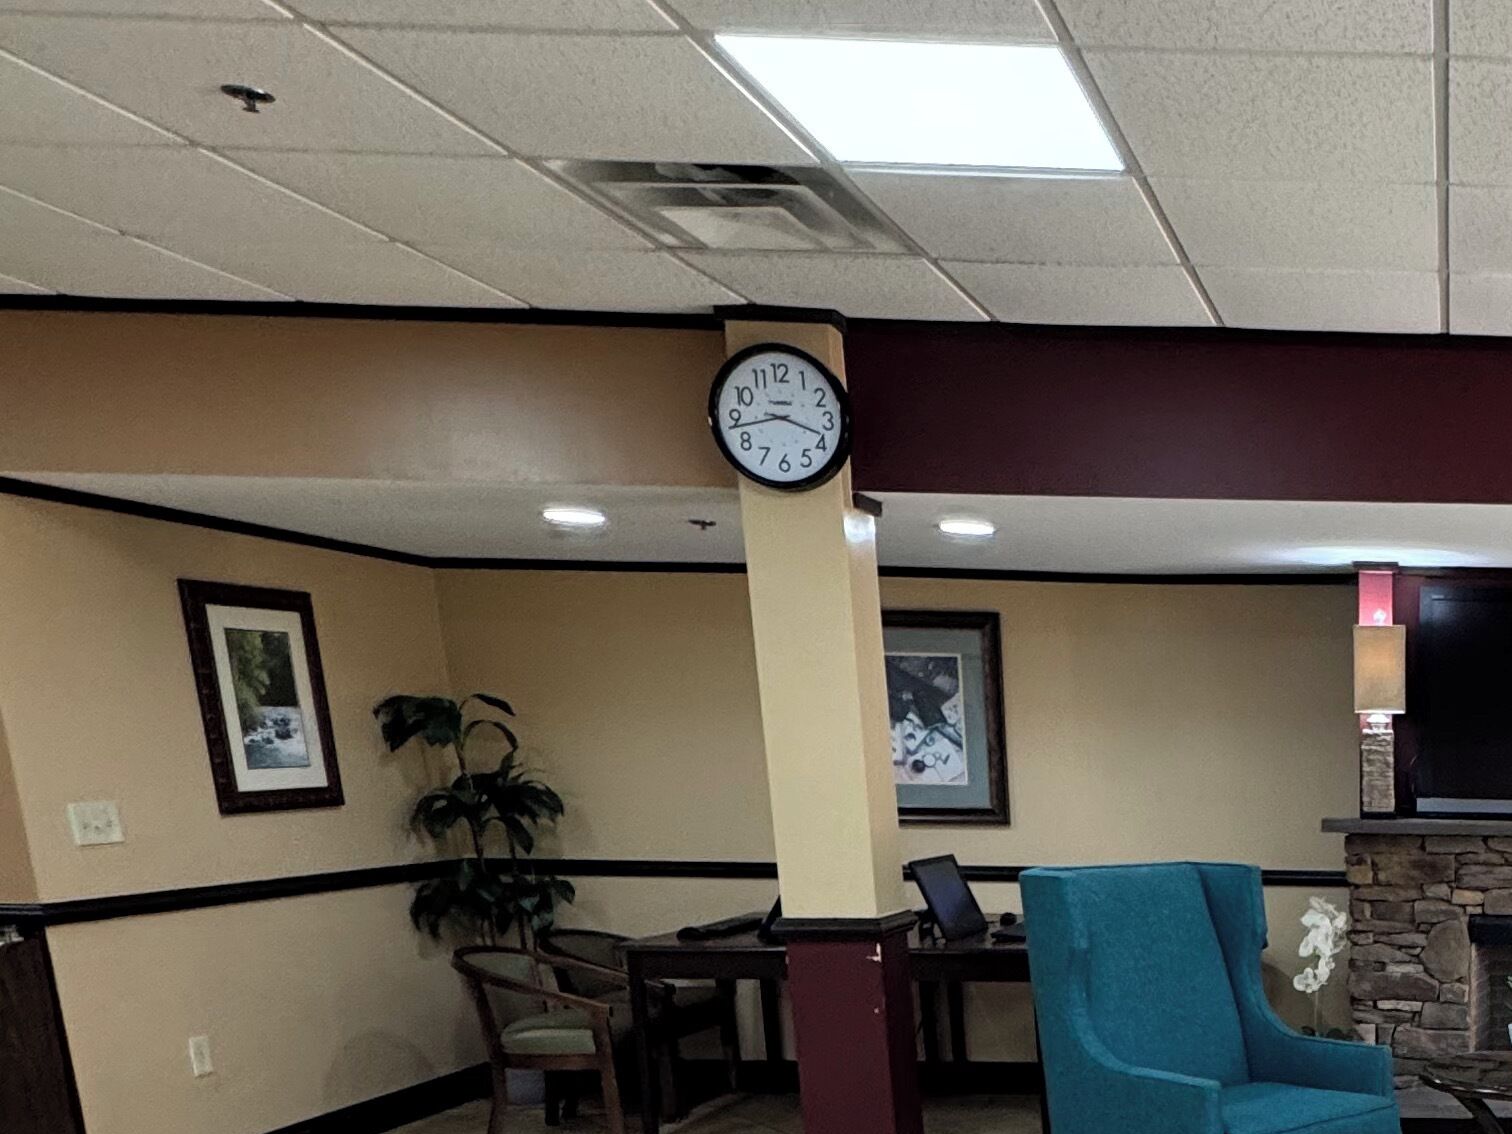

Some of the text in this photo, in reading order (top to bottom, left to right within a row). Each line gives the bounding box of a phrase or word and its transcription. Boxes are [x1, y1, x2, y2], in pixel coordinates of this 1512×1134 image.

[752, 368, 767, 389] 11
[769, 363, 790, 383] 12
[799, 370, 806, 391] 1
[734, 386, 754, 407] 10
[814, 387, 826, 408] 2
[728, 408, 742, 428] 9
[822, 411, 834, 431] 3
[740, 431, 752, 451] 8
[815, 433, 828, 452] 4
[758, 446, 771, 466] 7
[778, 453, 791, 473] 6
[800, 449, 812, 468] 5
